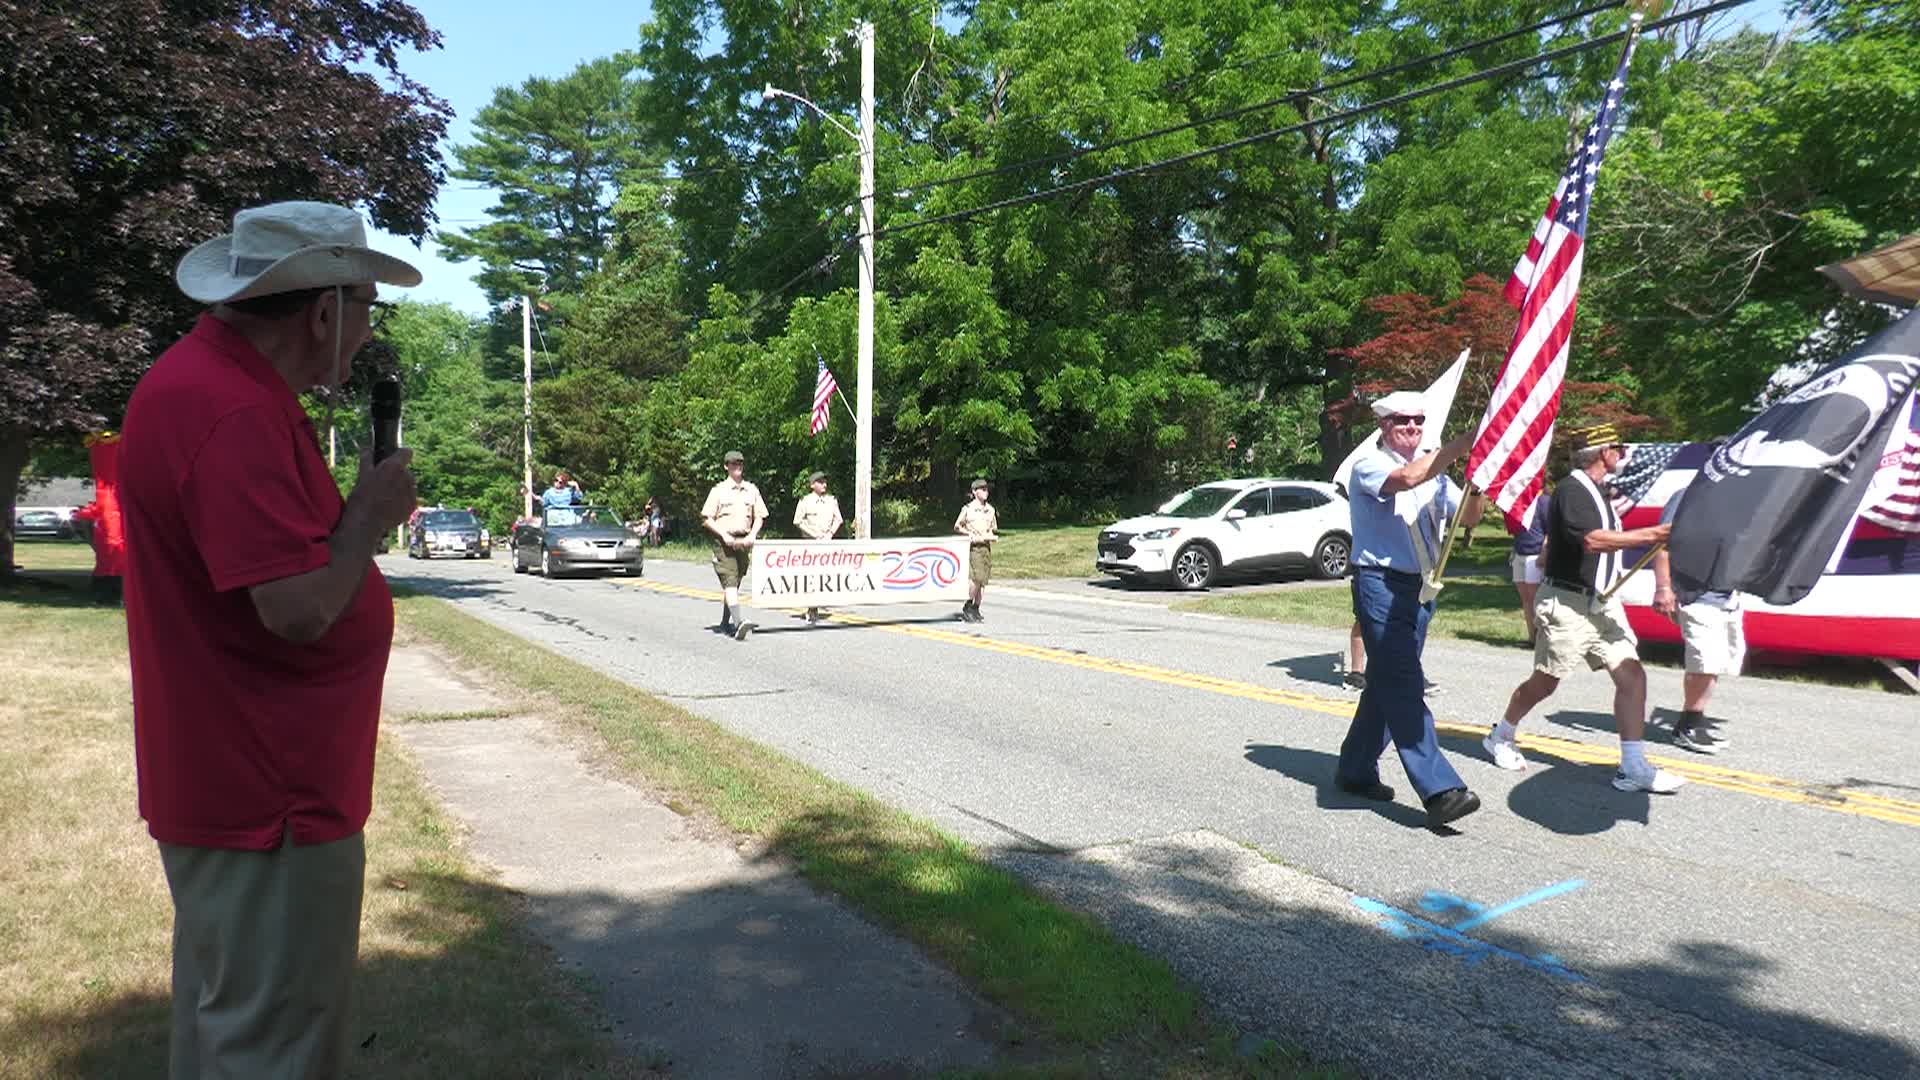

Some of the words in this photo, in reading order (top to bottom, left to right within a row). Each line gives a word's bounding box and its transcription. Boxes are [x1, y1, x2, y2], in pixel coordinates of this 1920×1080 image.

[764, 549, 865, 570] Celebrating
[882, 546, 961, 590] 250
[760, 573, 876, 595] AMERICA
